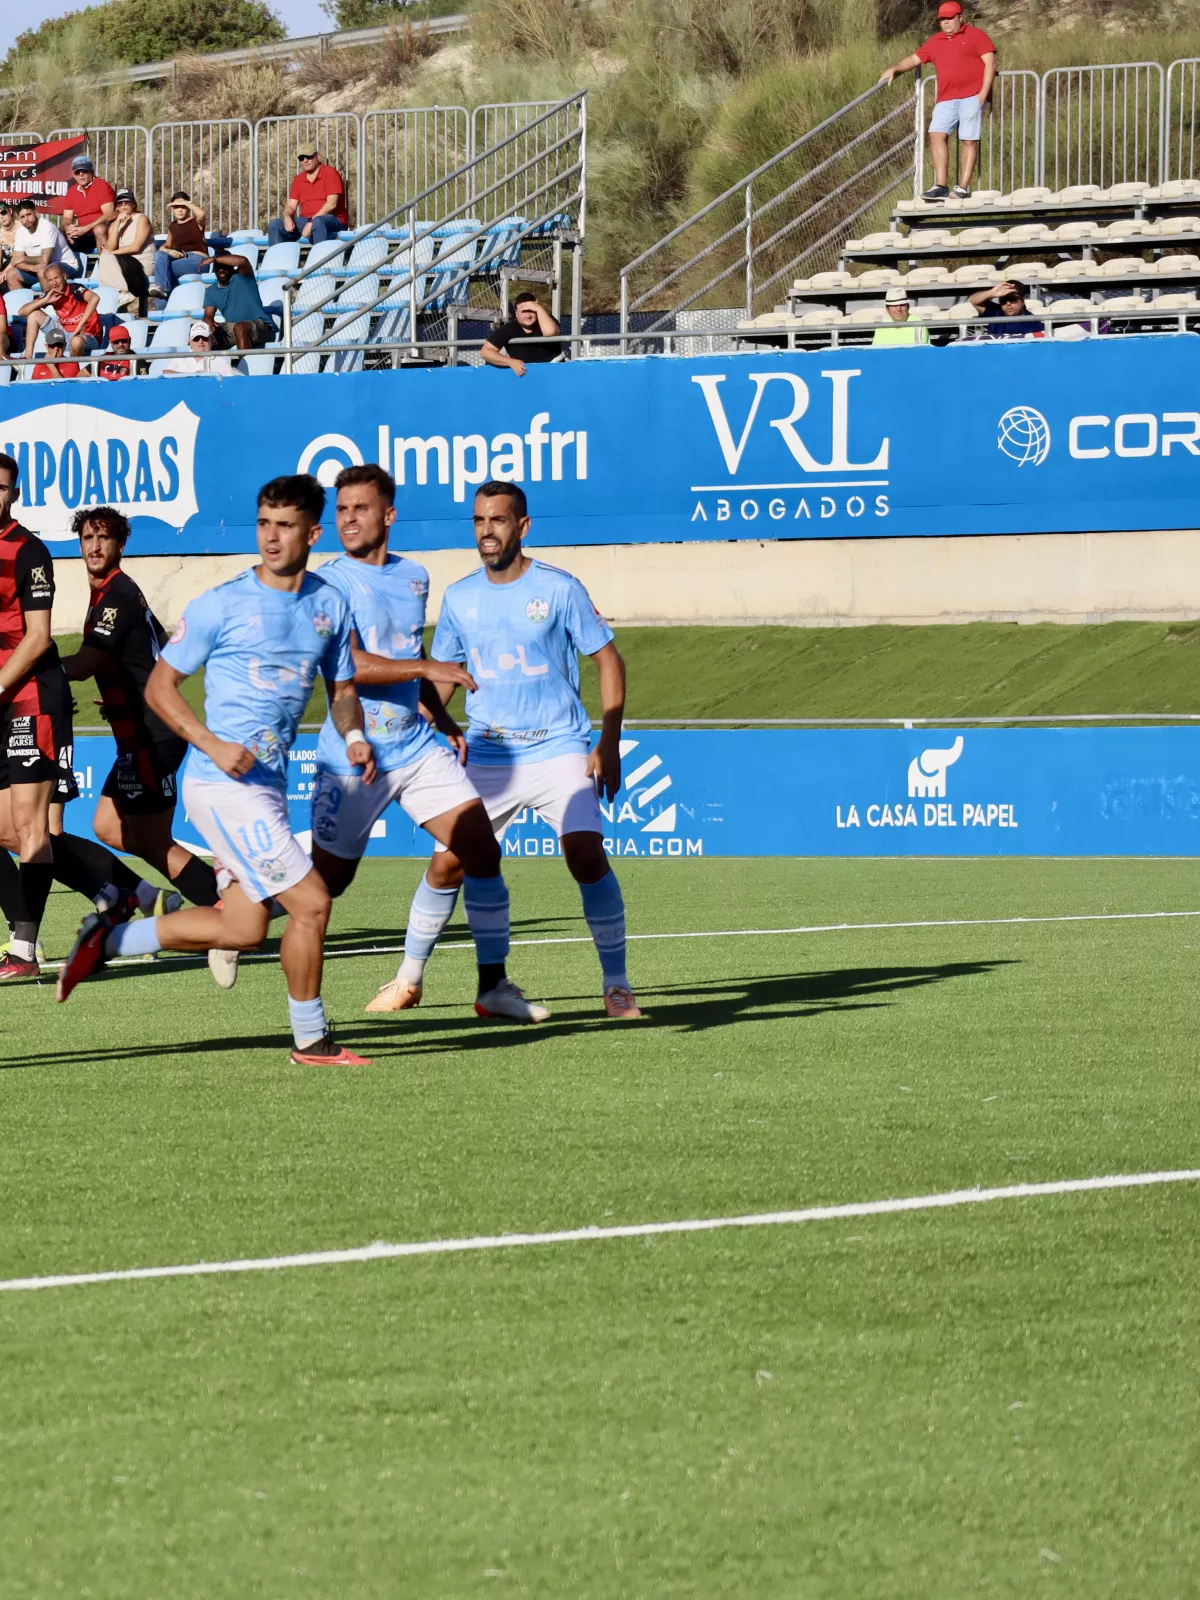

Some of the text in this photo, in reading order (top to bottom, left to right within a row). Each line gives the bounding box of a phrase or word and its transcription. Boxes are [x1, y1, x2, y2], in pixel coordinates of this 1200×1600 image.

[10, 178, 43, 195] FÚTBOL
[45, 181, 68, 197] CLUB
[691, 369, 889, 475] VRL
[1068, 412, 1200, 459] COR
[378, 412, 587, 502] Impafri
[691, 495, 889, 522] ABOGADOS
[836, 804, 1018, 828] LA CASA DEL PAPEL
[237, 819, 273, 858] 10
